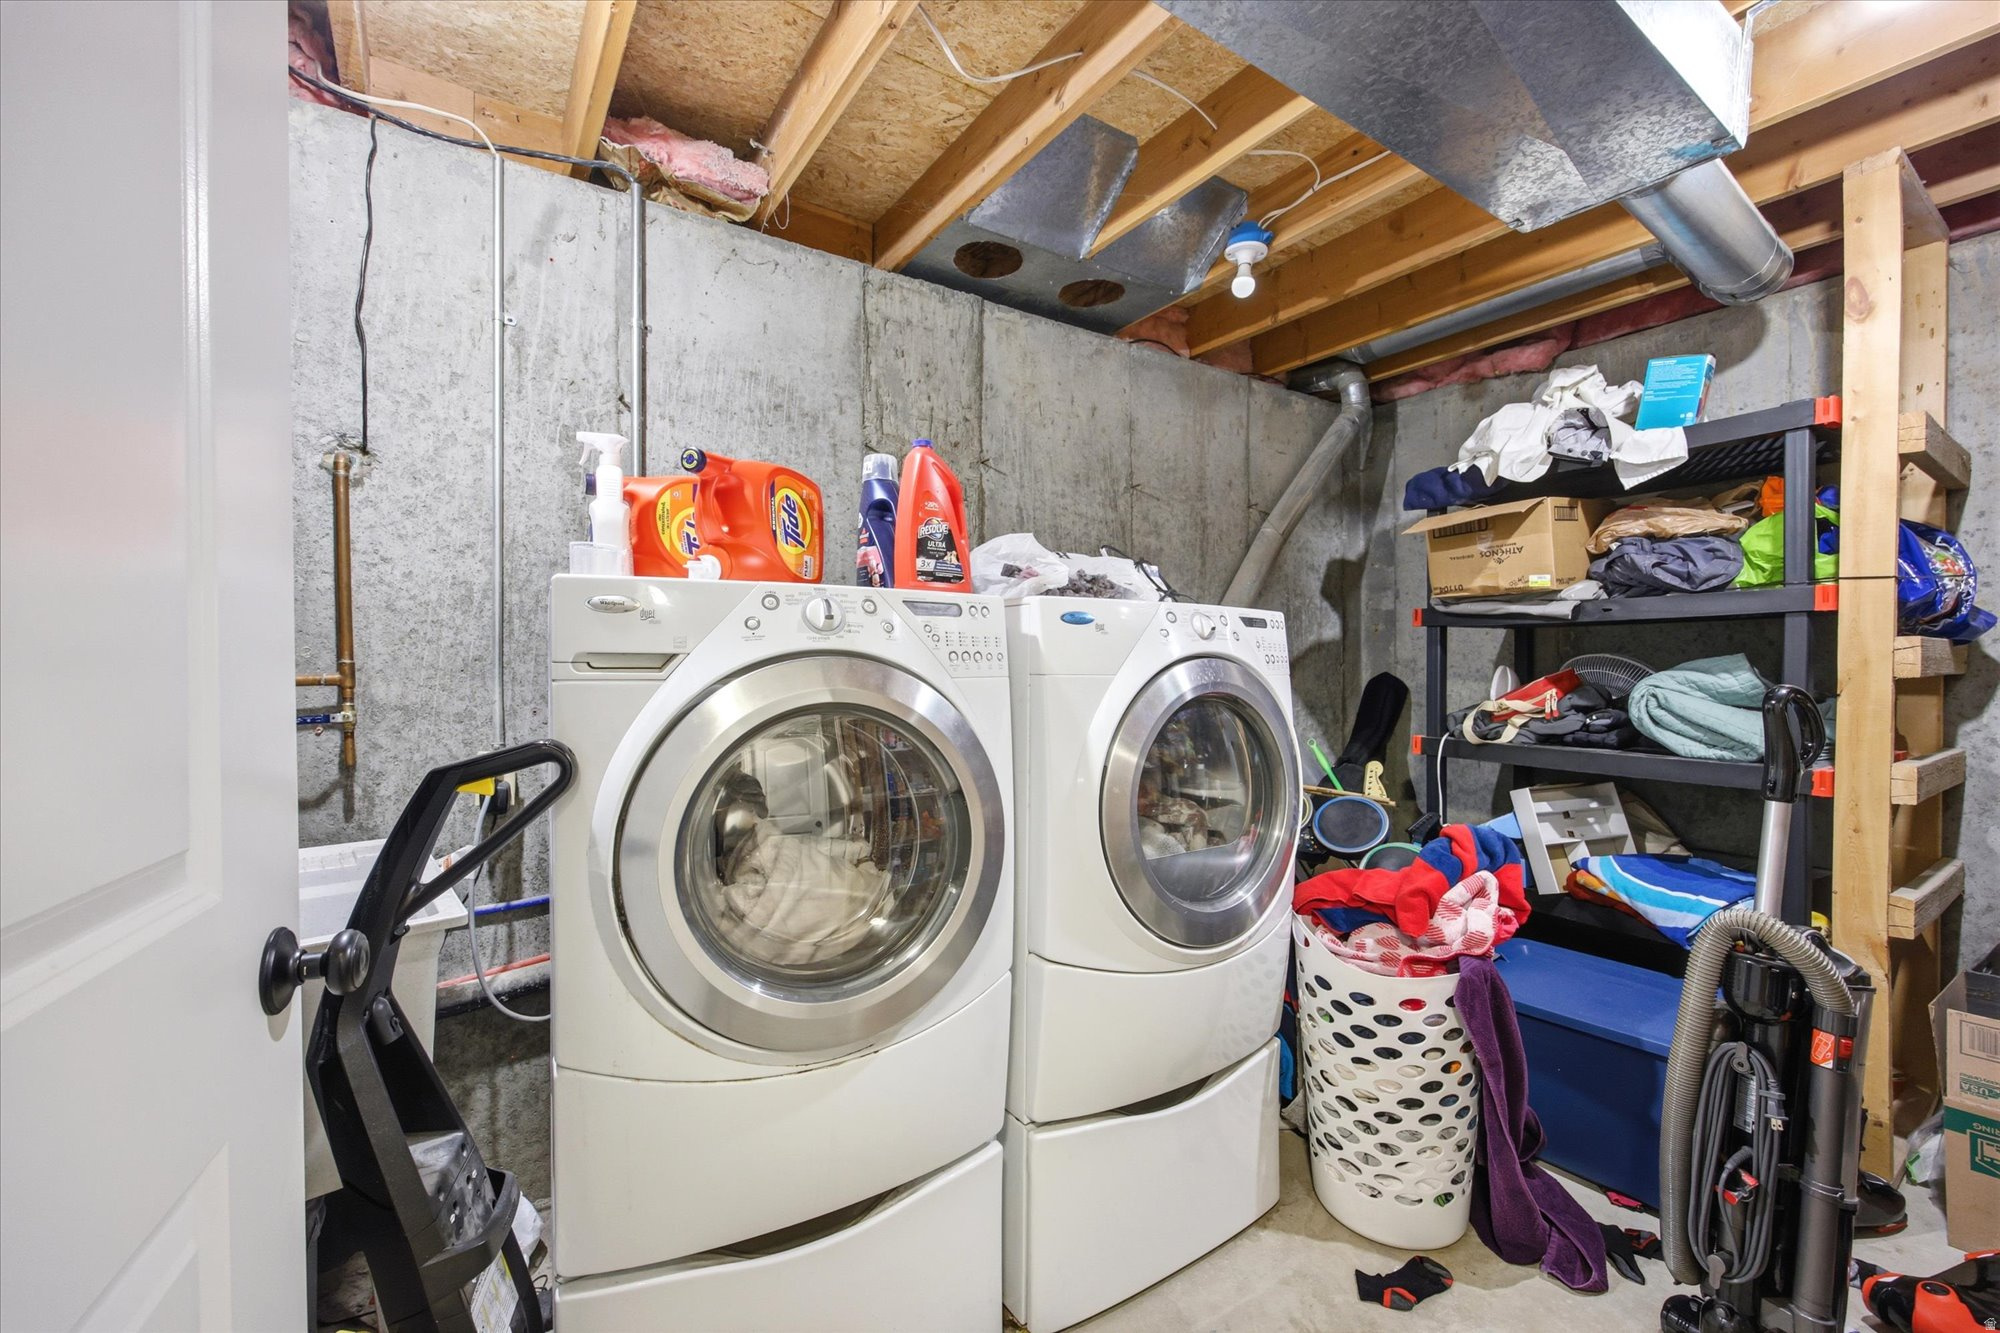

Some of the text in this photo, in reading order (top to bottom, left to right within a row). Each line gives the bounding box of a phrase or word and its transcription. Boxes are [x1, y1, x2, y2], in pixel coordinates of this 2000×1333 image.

[782, 494, 806, 549] Tide
[920, 523, 949, 536] RESOLVE
[1480, 546, 1524, 559] ATHENOS
[1961, 1081, 1989, 1096] USA
